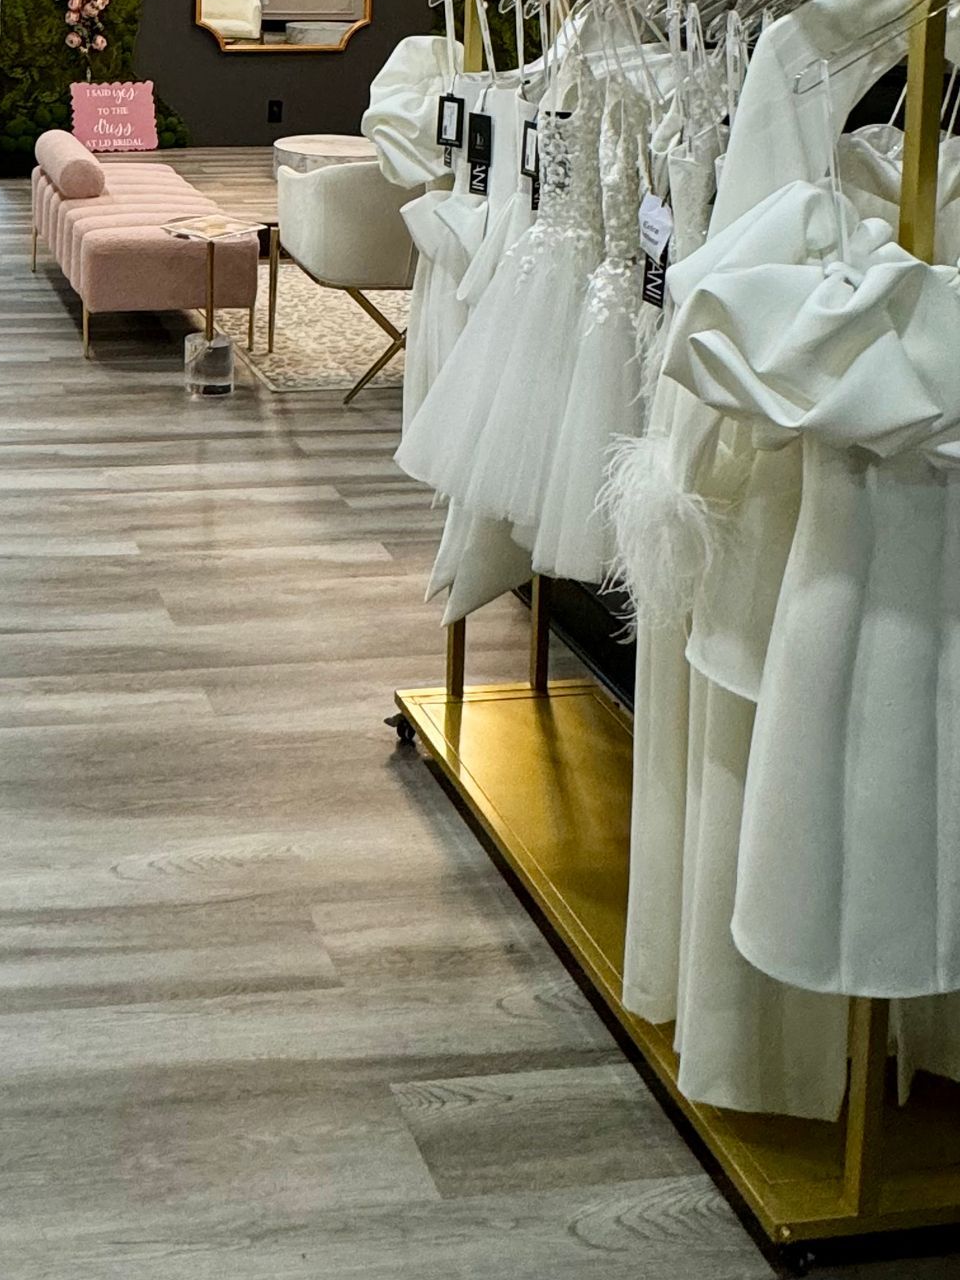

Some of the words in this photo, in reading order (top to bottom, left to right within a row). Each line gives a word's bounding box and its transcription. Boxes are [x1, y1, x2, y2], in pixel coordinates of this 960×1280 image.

[91, 88, 111, 97] SAID
[112, 87, 136, 104] yes
[97, 107, 110, 115] TO
[111, 106, 129, 115] THE
[93, 118, 133, 137] dress
[86, 139, 97, 147] AT
[112, 138, 143, 147] BRIDAL
